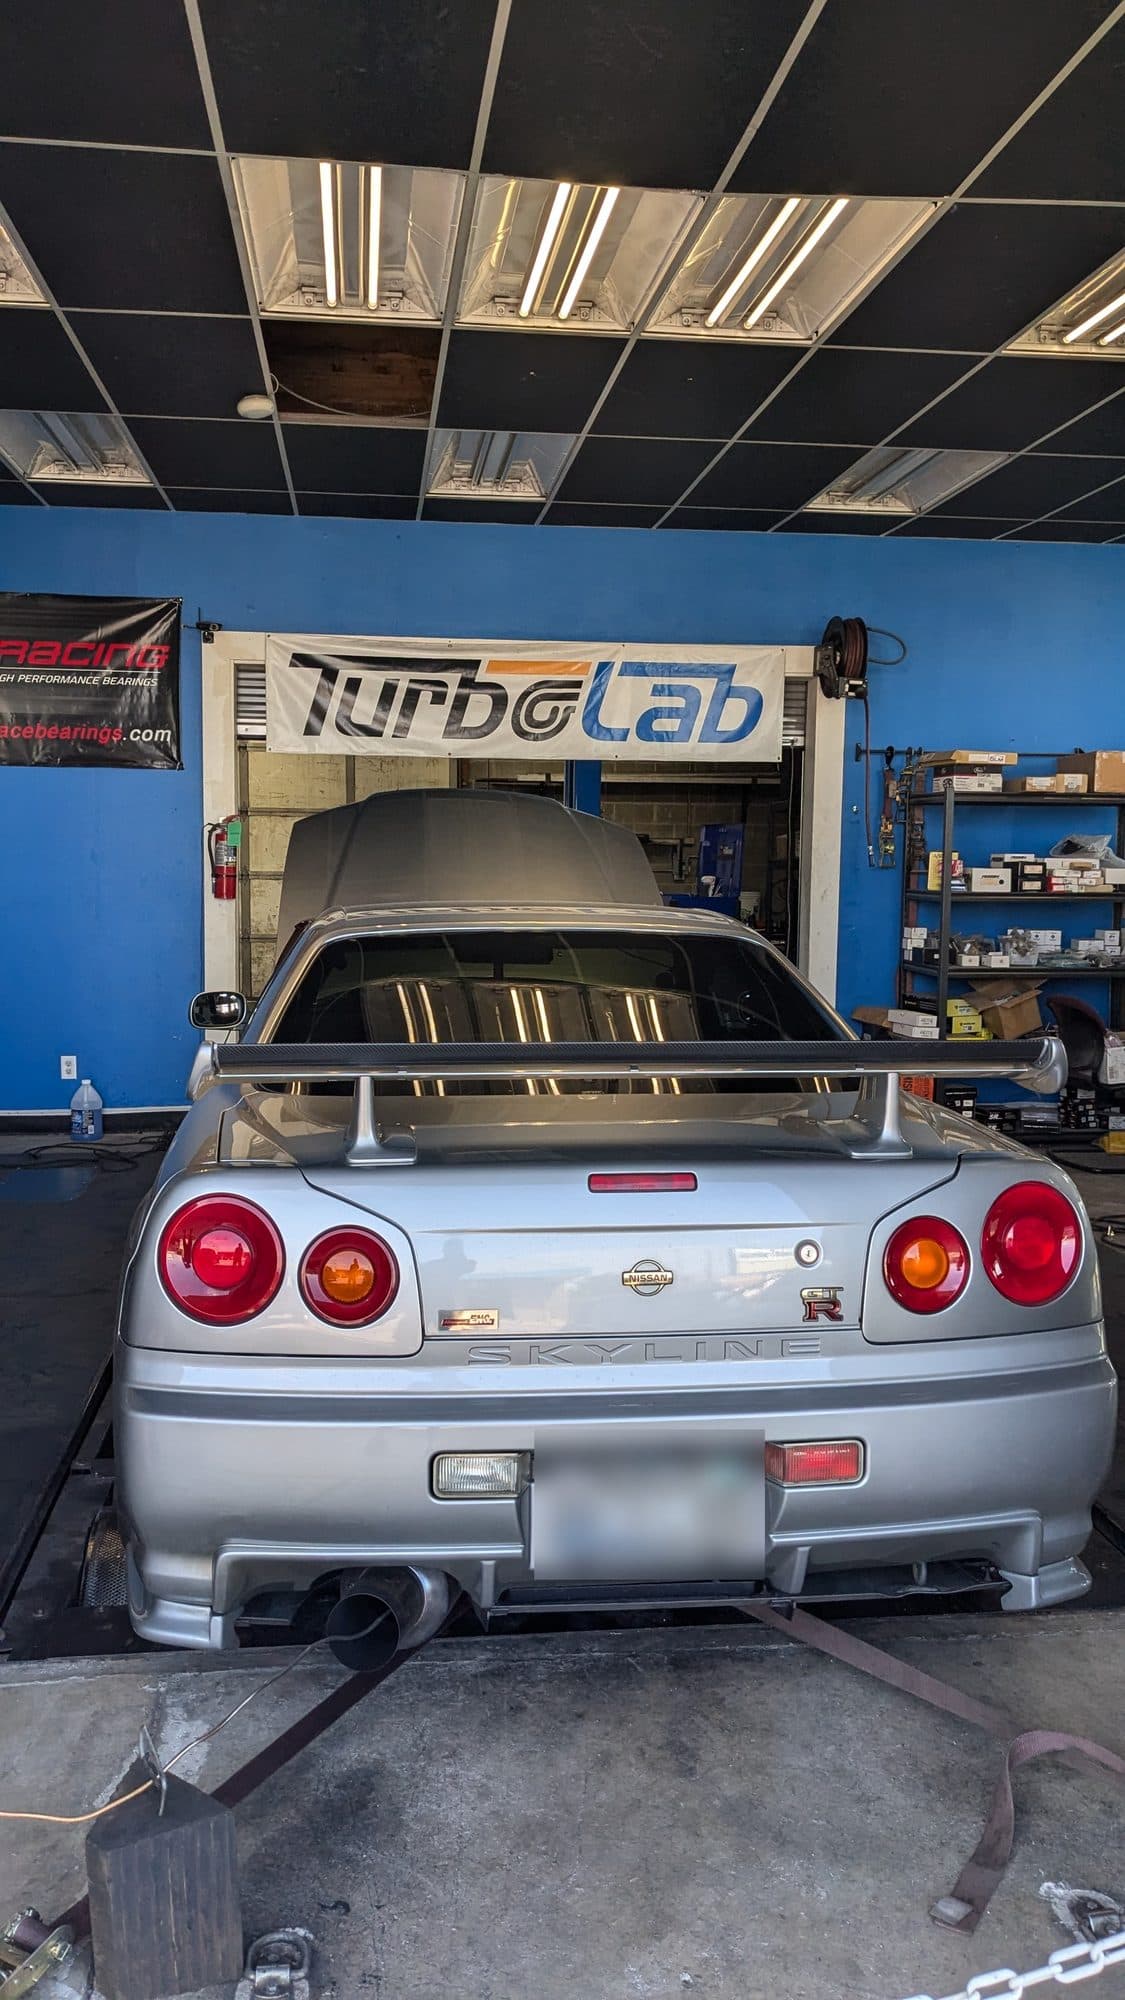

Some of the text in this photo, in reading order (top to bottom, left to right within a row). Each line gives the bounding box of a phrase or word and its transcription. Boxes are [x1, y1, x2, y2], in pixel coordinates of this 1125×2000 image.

[17, 674, 100, 685] PERFORMANCE
[102, 677, 158, 687] BEARINGS
[628, 1274, 668, 1283] NISSAN
[468, 1337, 821, 1367] SKYLINE
